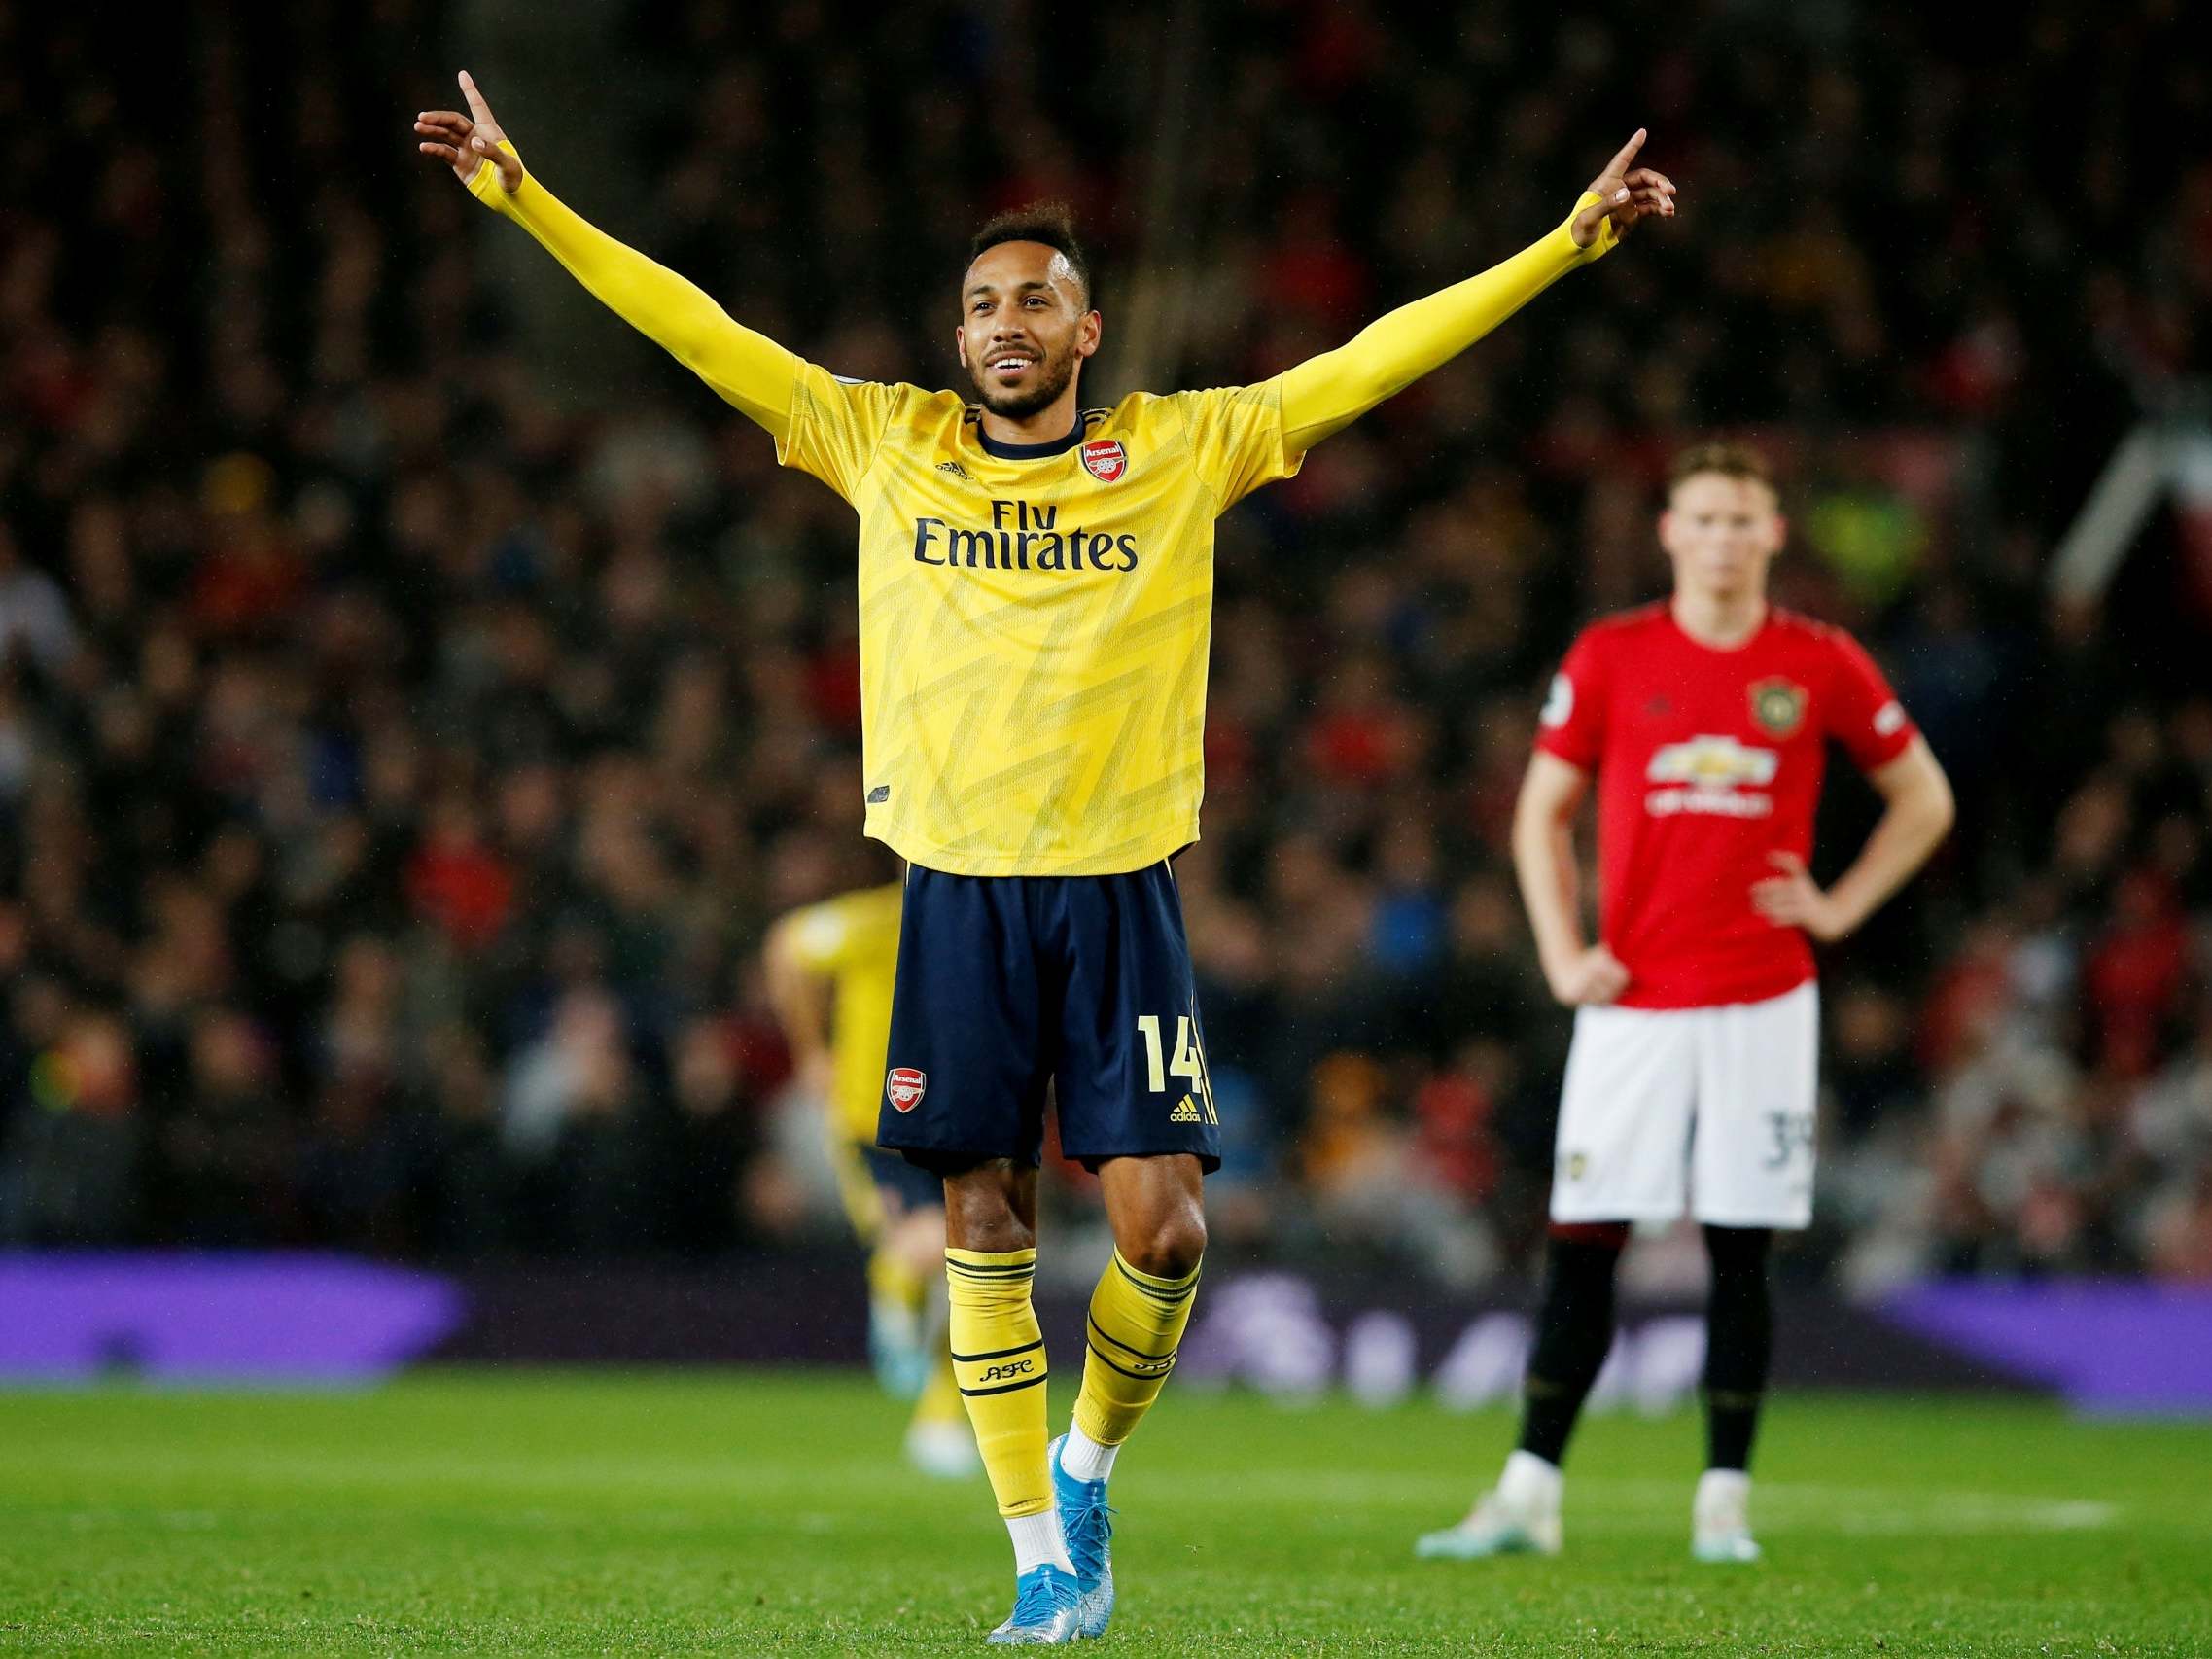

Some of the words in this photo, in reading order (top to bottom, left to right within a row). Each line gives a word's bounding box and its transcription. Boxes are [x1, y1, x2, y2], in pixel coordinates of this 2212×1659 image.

[1086, 445, 1119, 457] Arsenal
[991, 500, 1057, 531] Fly
[914, 517, 1139, 572] Emirates
[1137, 1015, 1202, 1094] 14
[893, 1074, 921, 1083] Arsenal
[1170, 1112, 1202, 1122] adidas
[979, 1359, 1035, 1382] AFC
